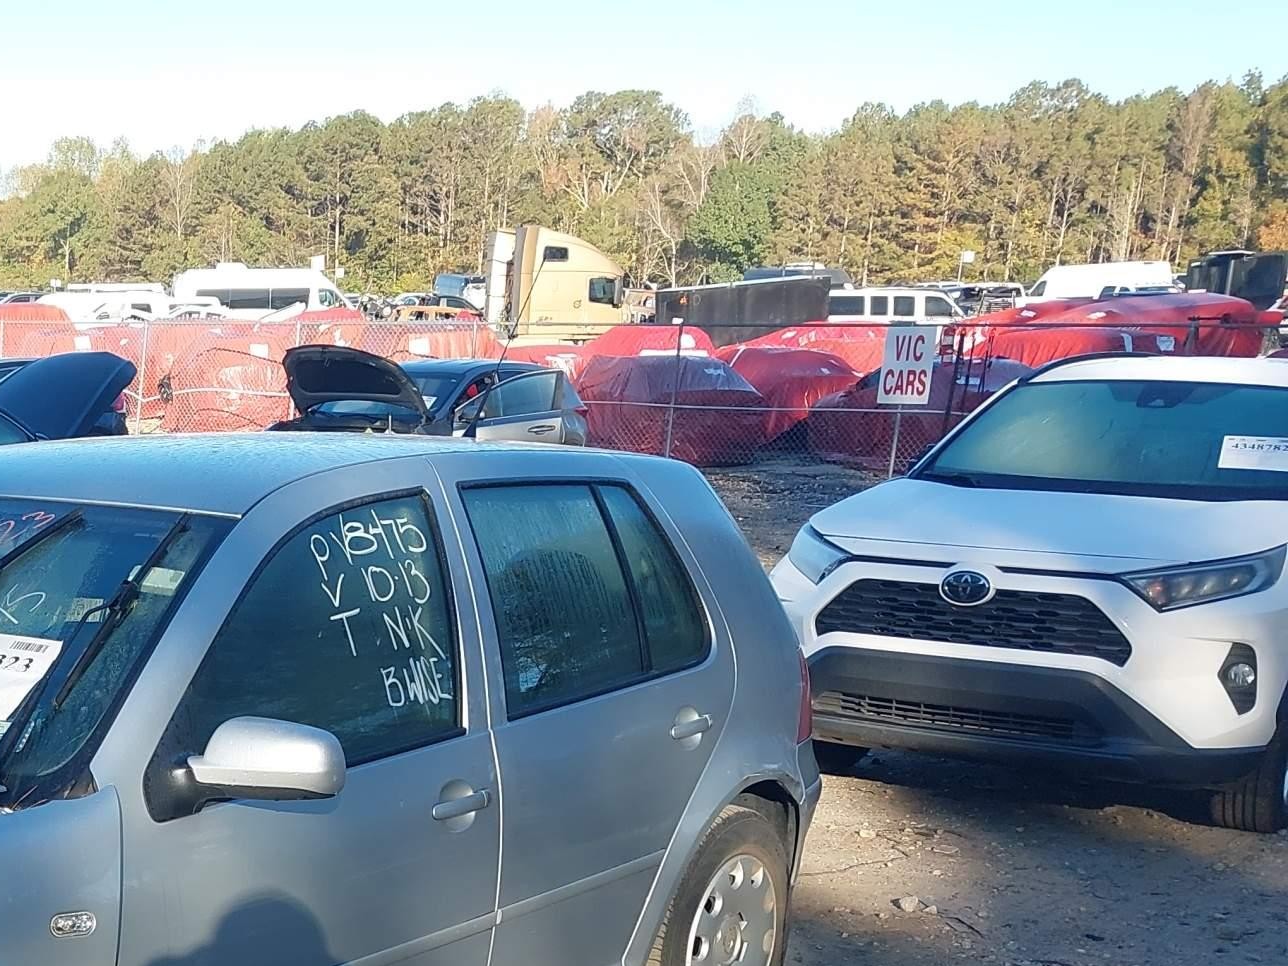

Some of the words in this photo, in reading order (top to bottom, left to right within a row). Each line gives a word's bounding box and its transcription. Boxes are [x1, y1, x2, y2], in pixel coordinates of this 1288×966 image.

[895, 334, 926, 362] VIC
[883, 368, 928, 397] CARS
[320, 572, 345, 609] V
[329, 607, 362, 657] T
